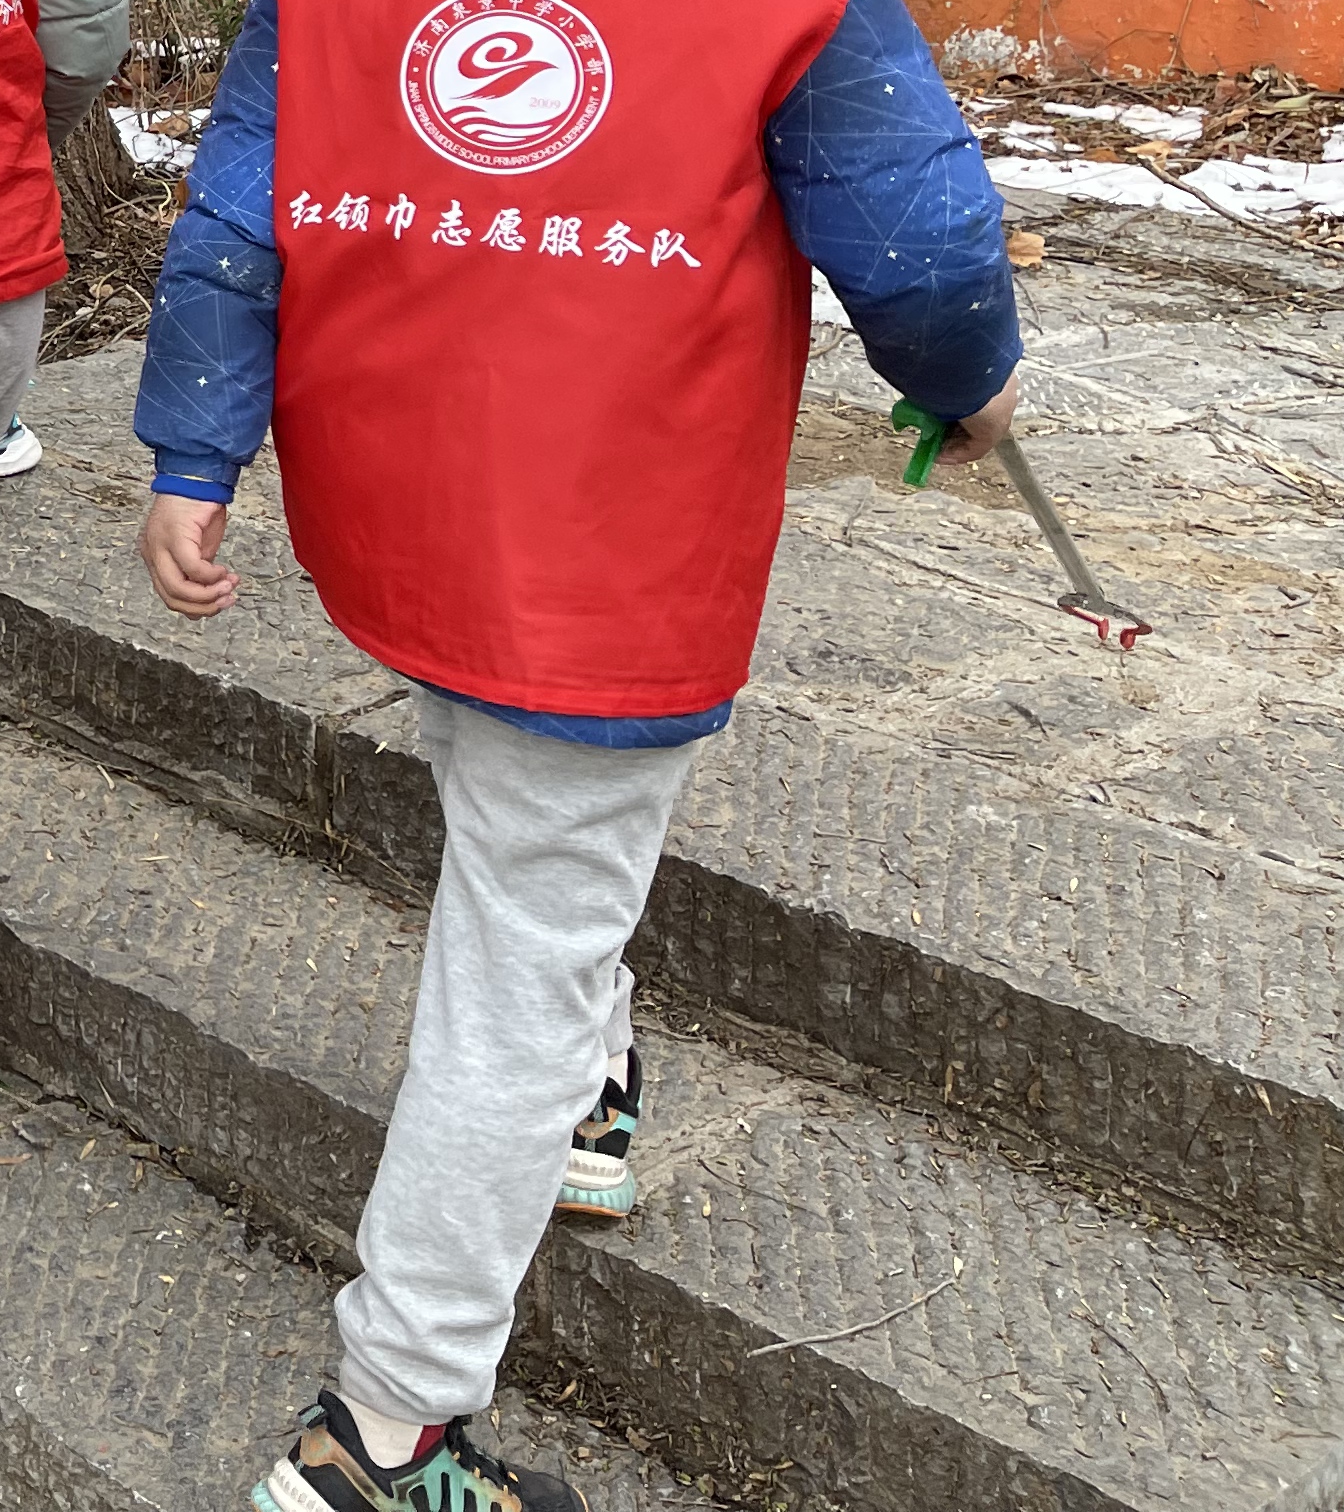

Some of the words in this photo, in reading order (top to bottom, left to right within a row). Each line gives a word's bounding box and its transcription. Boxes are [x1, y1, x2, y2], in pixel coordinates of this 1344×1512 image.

[529, 96, 562, 110] 2009
[288, 190, 702, 269] 红领巾志愿服务队
